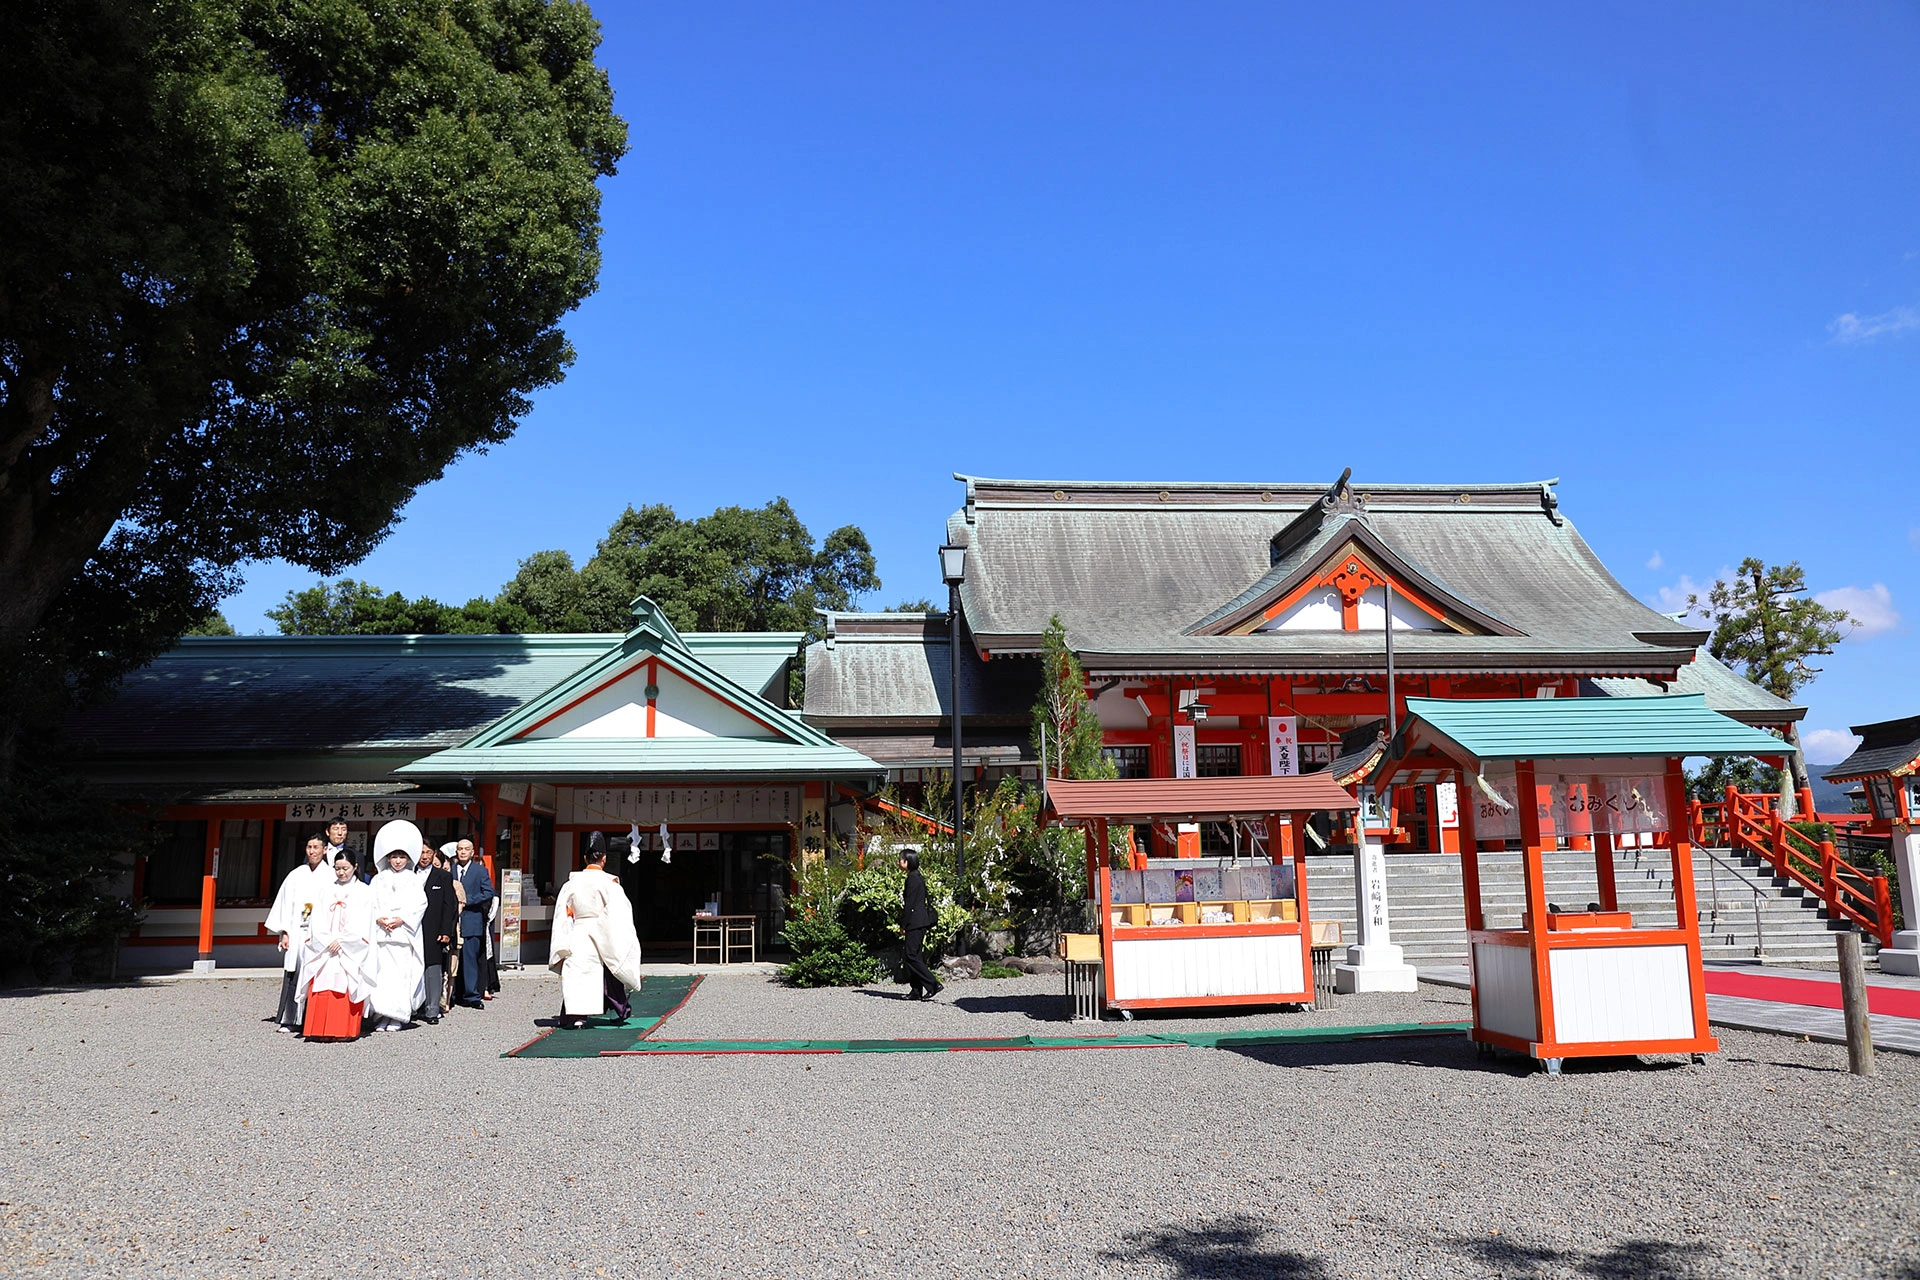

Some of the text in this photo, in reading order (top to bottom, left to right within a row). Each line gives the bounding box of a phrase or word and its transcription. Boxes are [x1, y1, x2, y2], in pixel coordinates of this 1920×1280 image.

[1279, 745, 1291, 775] 天皇陛下
[372, 803, 410, 818] 授与所
[1569, 794, 1637, 813] おみくじ
